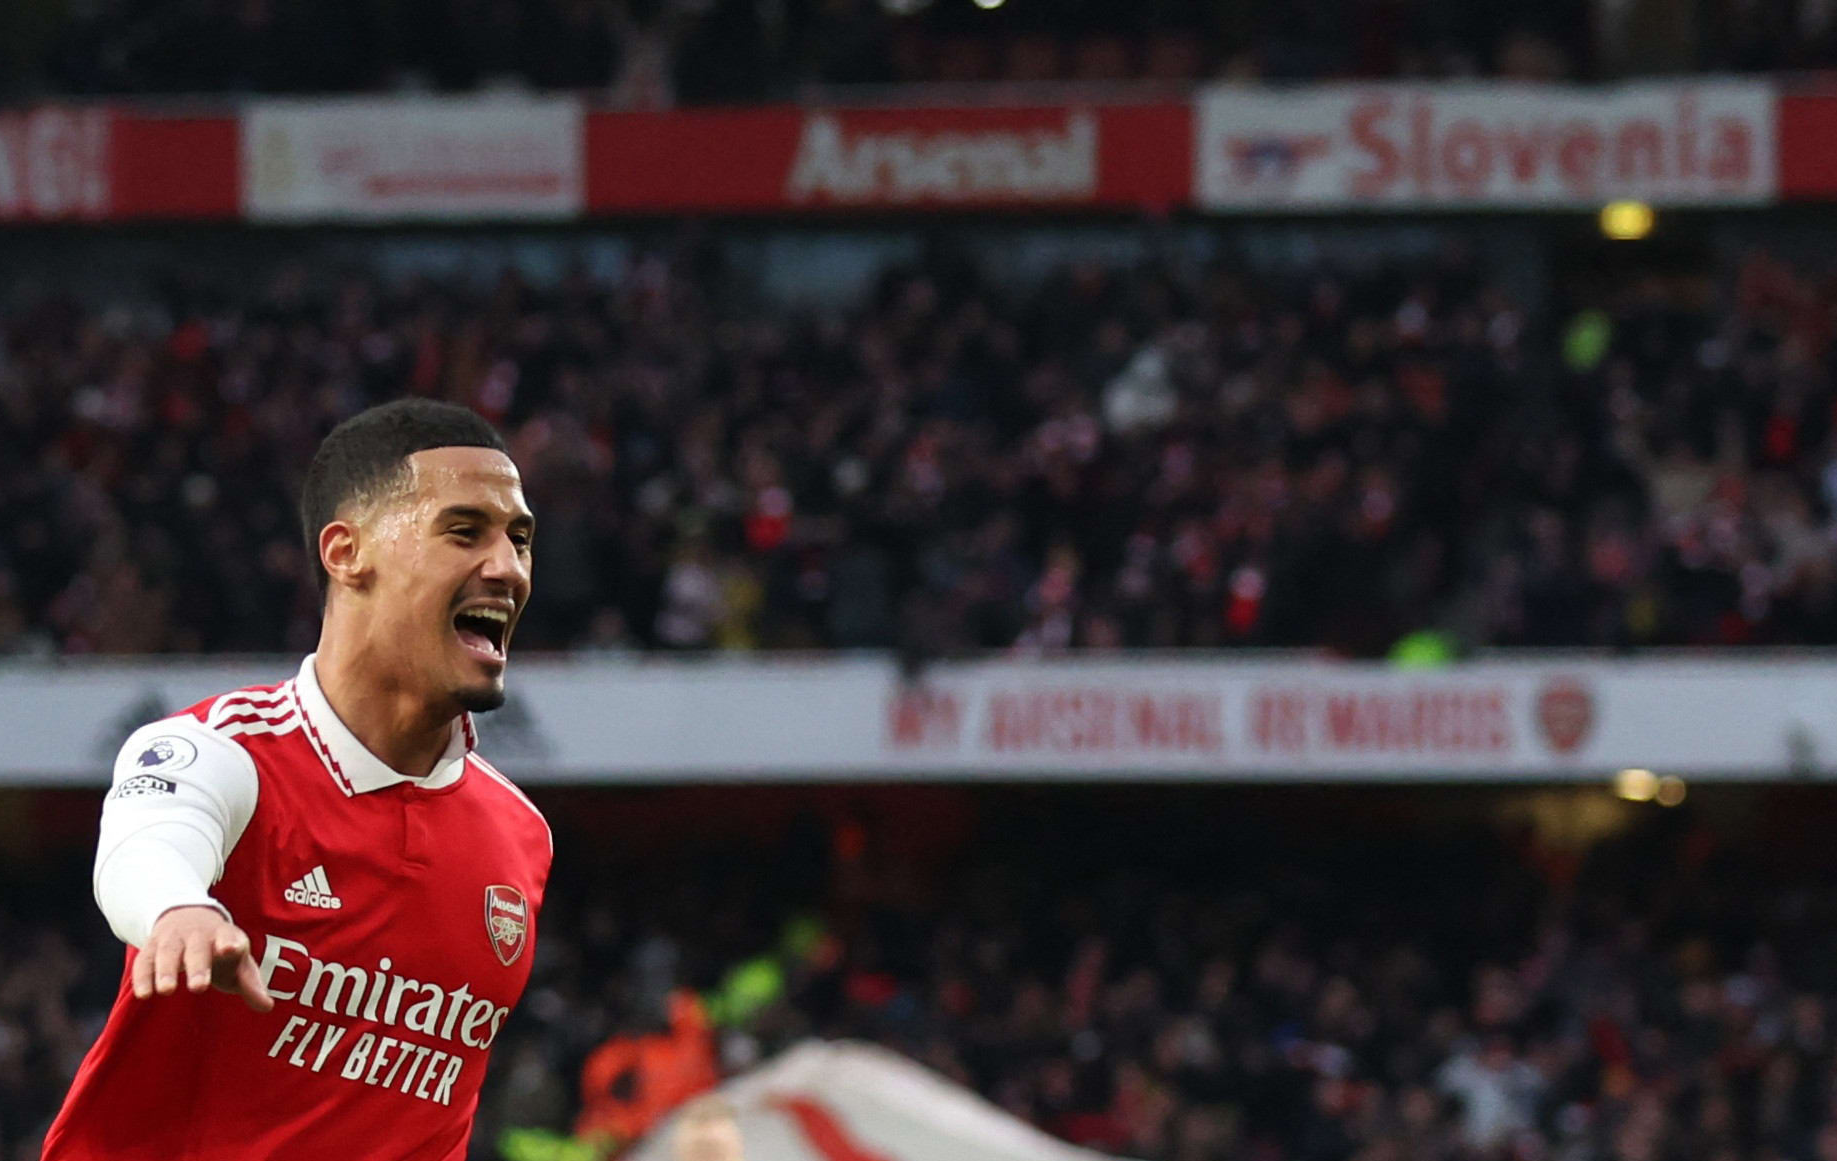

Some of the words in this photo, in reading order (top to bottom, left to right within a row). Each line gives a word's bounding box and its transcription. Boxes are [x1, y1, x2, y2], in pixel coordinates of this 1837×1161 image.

[790, 112, 1098, 201] Arsenal
[1348, 90, 1754, 197] Slovenia
[284, 888, 342, 909] adidas
[259, 934, 509, 1050] Emirates
[268, 1015, 347, 1073] FLY
[340, 1032, 463, 1106] BETTER
